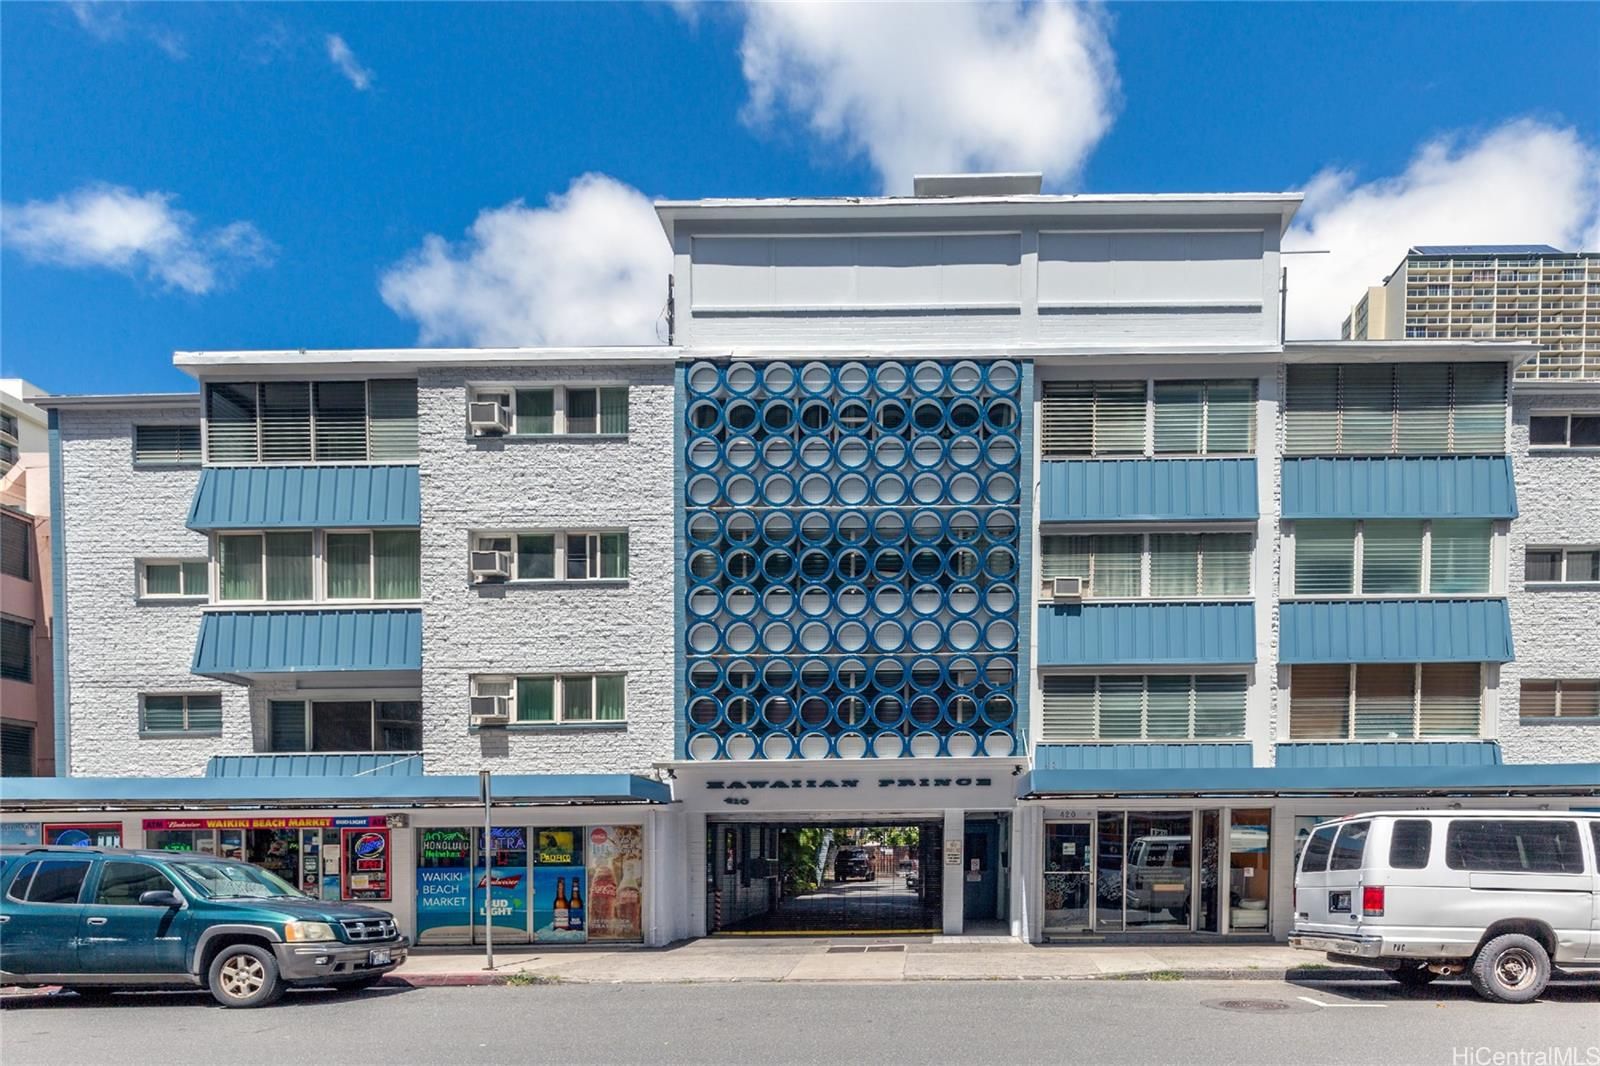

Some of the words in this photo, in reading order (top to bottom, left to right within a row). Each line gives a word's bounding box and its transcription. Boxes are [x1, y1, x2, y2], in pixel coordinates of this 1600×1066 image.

[706, 779, 859, 790] HAWAIIAN
[878, 777, 992, 787] PRINCE
[1060, 810, 1077, 818] 420
[168, 820, 201, 829] Budweiser
[206, 819, 250, 829] WAIKIKI
[252, 818, 286, 828] BEACH
[288, 818, 332, 828] MARKET
[423, 840, 469, 850] HONOLULU
[422, 872, 463, 881] WAIKIKI
[422, 885, 459, 894] BEACH
[422, 897, 467, 907] MARKET
[480, 907, 512, 916] LGHT
